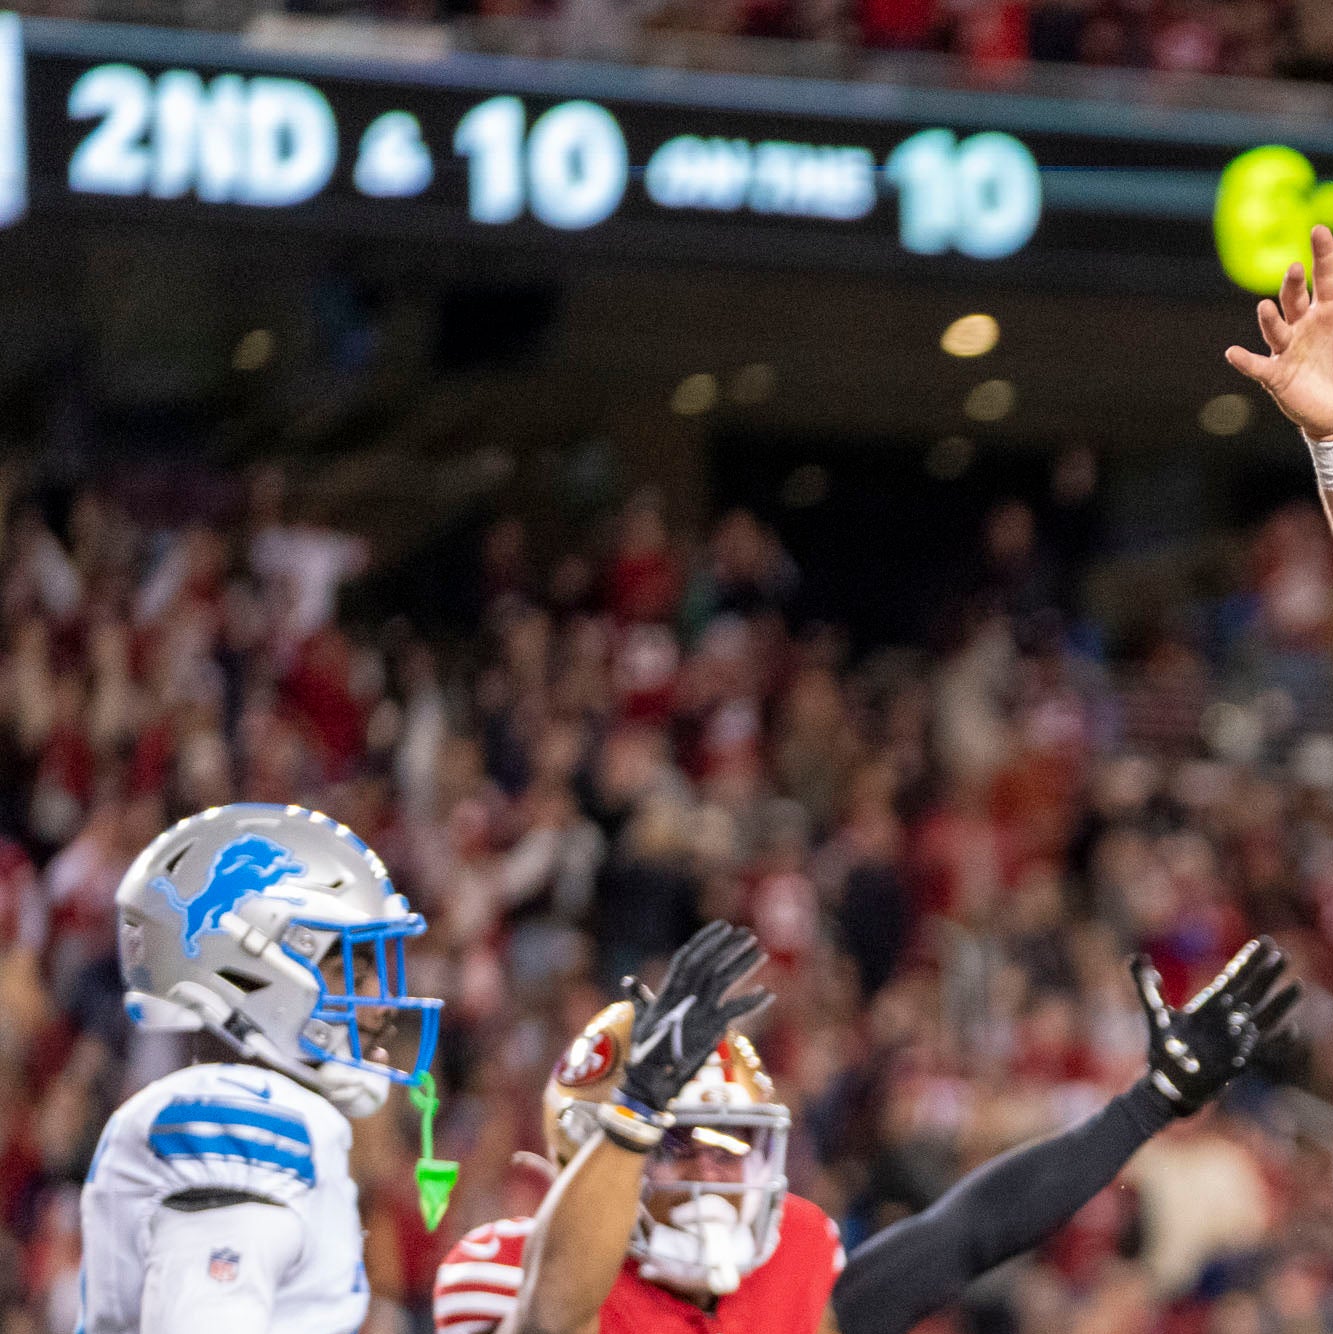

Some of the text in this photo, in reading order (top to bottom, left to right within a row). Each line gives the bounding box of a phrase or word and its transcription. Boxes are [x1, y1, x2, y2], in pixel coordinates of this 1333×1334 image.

[66, 62, 338, 208] 2ND
[453, 95, 631, 231] 10
[887, 127, 1043, 261] 10
